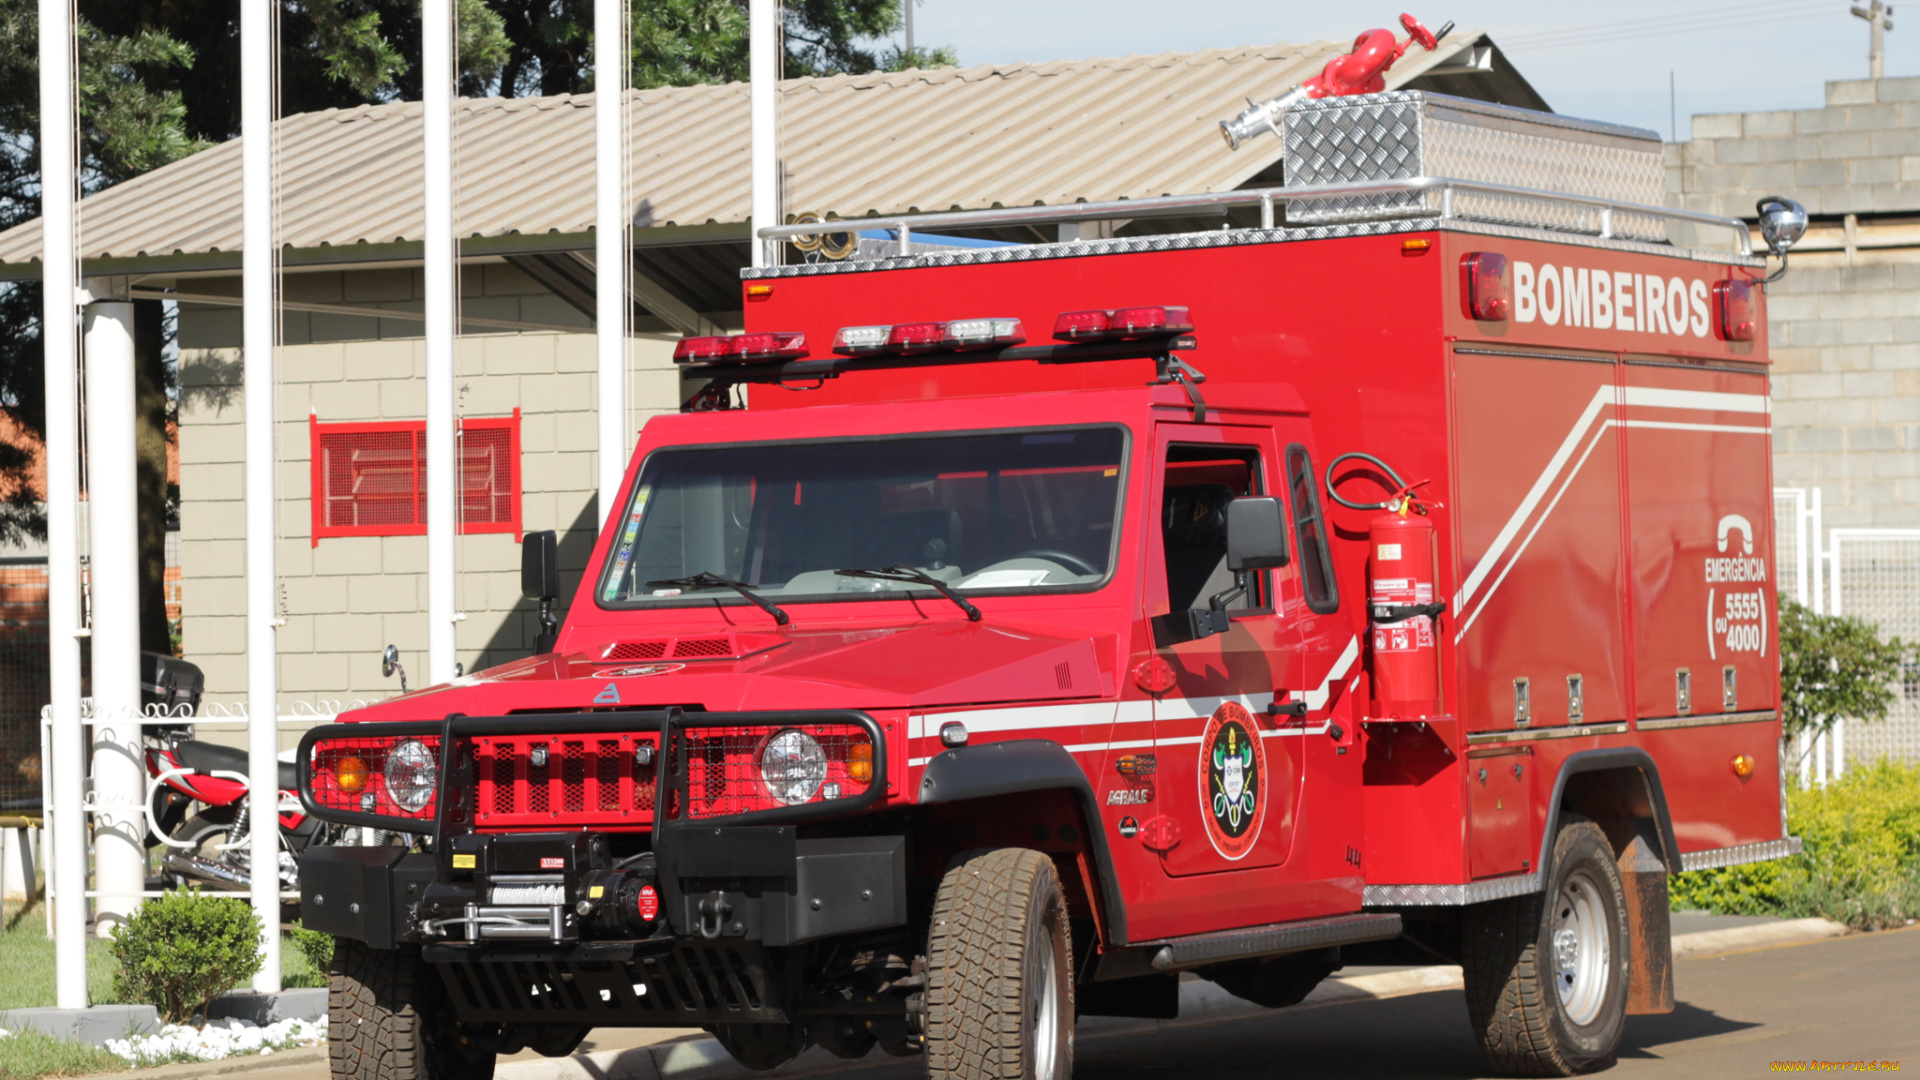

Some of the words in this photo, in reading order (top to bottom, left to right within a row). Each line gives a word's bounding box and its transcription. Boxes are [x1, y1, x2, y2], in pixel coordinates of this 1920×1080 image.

[1513, 261, 1709, 338] BOMBEIROS
[1705, 551, 1766, 583] EMERGÊNCIA
[1725, 593, 1759, 620] 5555
[1726, 624, 1760, 652] 4000
[1202, 721, 1218, 774] CORPO
[1217, 707, 1228, 724] DE
[1229, 706, 1264, 770] BOMBEIROS
[1106, 788, 1149, 806] AGRALE
